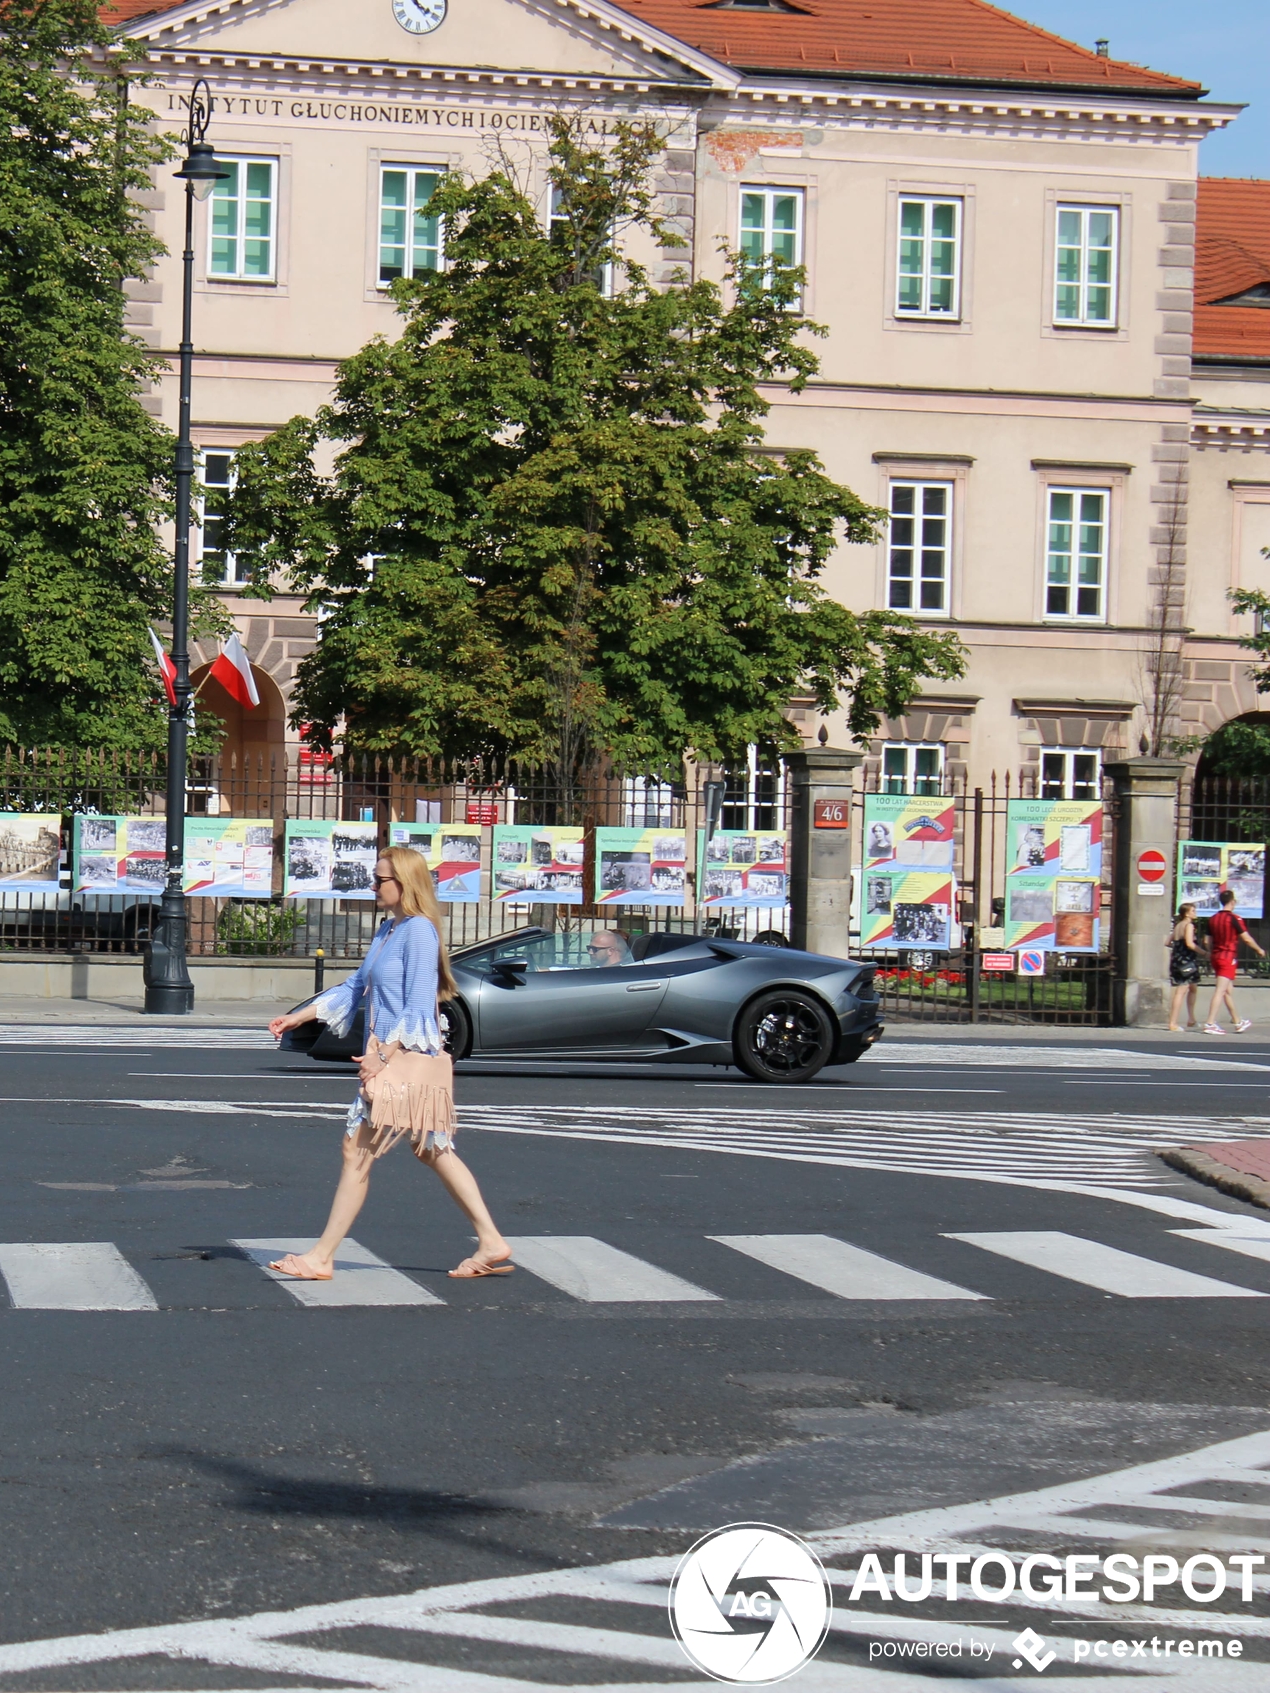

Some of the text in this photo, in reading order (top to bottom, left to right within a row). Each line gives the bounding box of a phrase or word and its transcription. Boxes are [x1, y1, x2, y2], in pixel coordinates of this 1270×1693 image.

[168, 94, 283, 116] INSTYTUT
[291, 102, 474, 128] GŁUCHONIEMYCH
[876, 797, 891, 805] 100
[821, 805, 843, 821] 4/6
